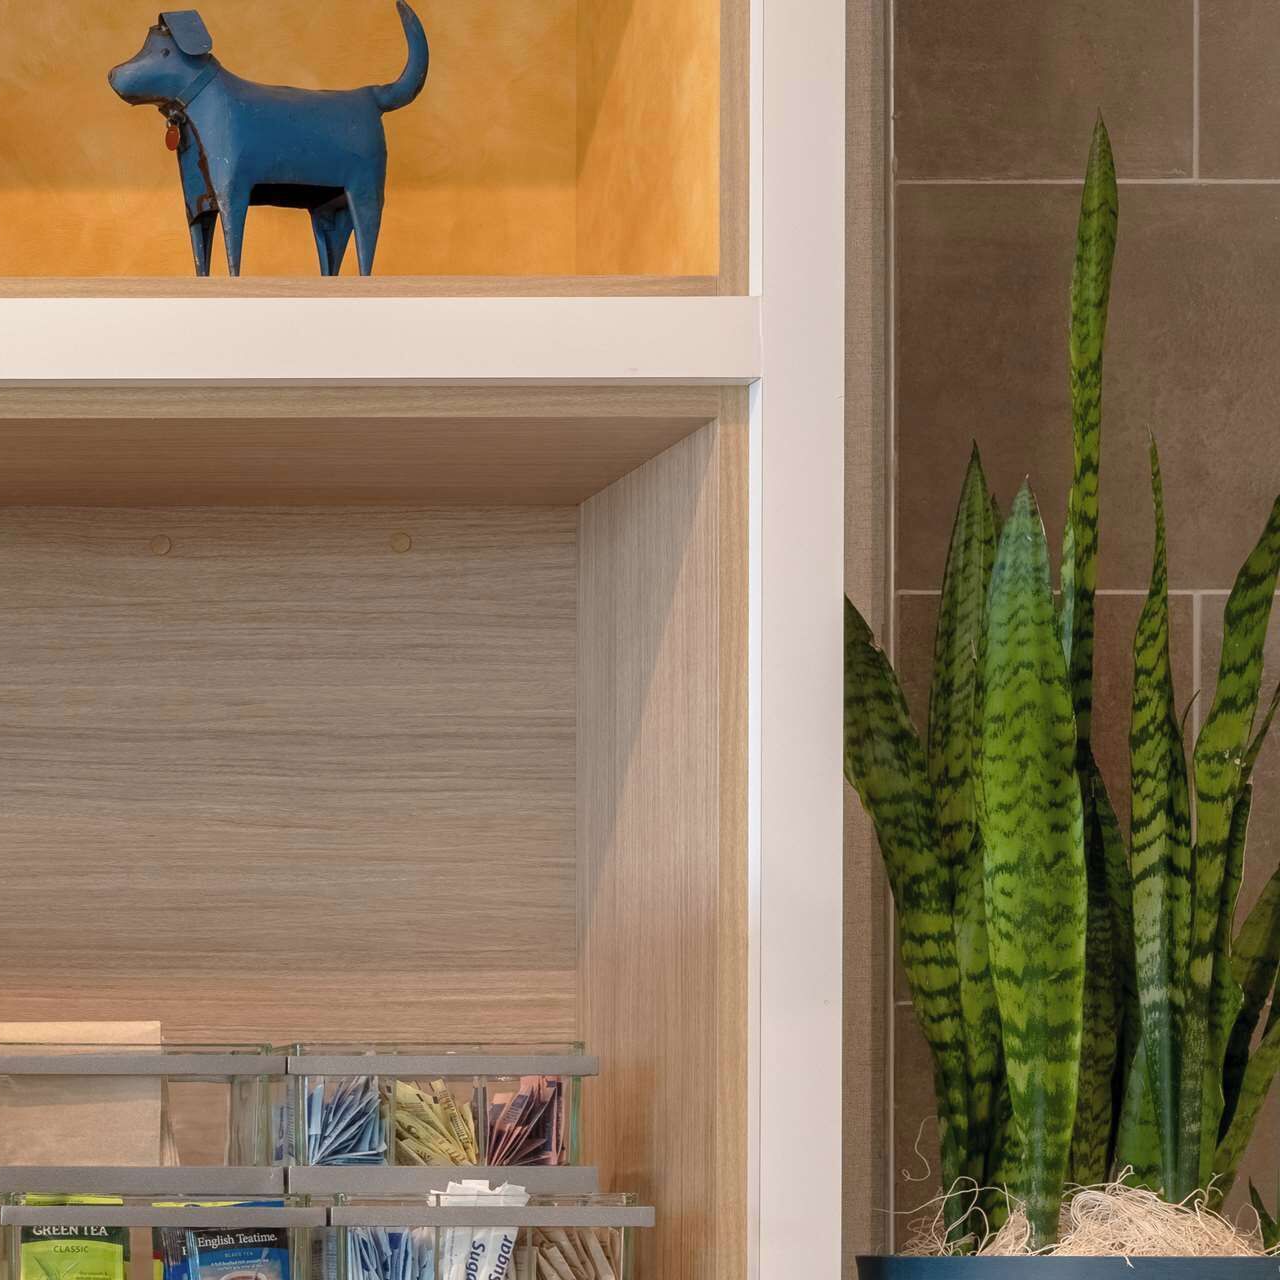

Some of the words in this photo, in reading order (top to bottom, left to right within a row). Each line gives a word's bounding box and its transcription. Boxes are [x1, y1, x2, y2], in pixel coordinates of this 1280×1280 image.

[32, 1225, 79, 1236] GREEN
[83, 1225, 109, 1236] TEA
[197, 1233, 235, 1249] English
[236, 1231, 278, 1244] Teatime.
[53, 1245, 89, 1254] CLASSIC
